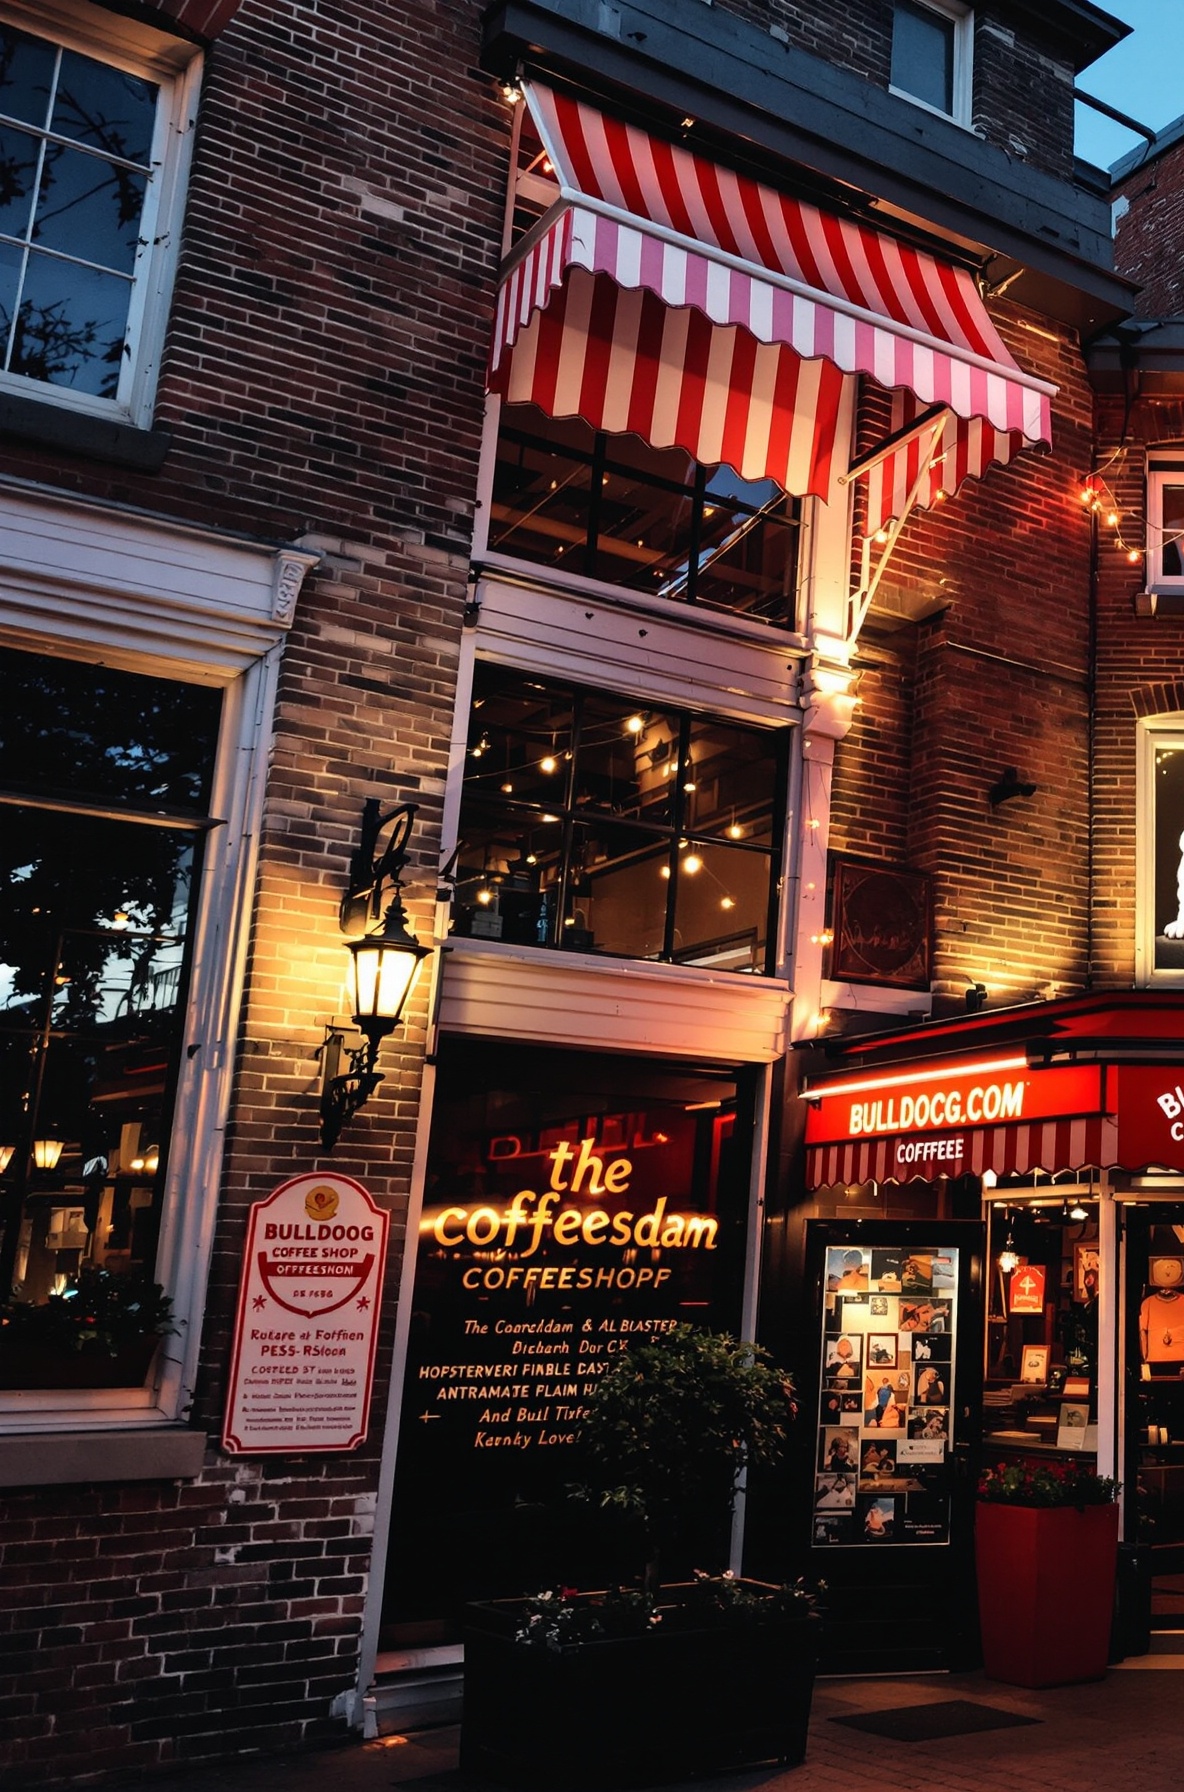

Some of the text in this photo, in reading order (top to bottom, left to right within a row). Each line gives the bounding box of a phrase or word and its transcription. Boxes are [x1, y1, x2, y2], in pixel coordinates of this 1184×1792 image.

[549, 1137, 633, 1195] the
[264, 1223, 374, 1241] BULLDOOG
[433, 1190, 719, 1258] coffeesdam
[272, 1247, 358, 1258] COFFEE SHOP
[464, 1320, 488, 1334] The
[581, 1318, 592, 1332] &
[479, 1407, 512, 1423] And
